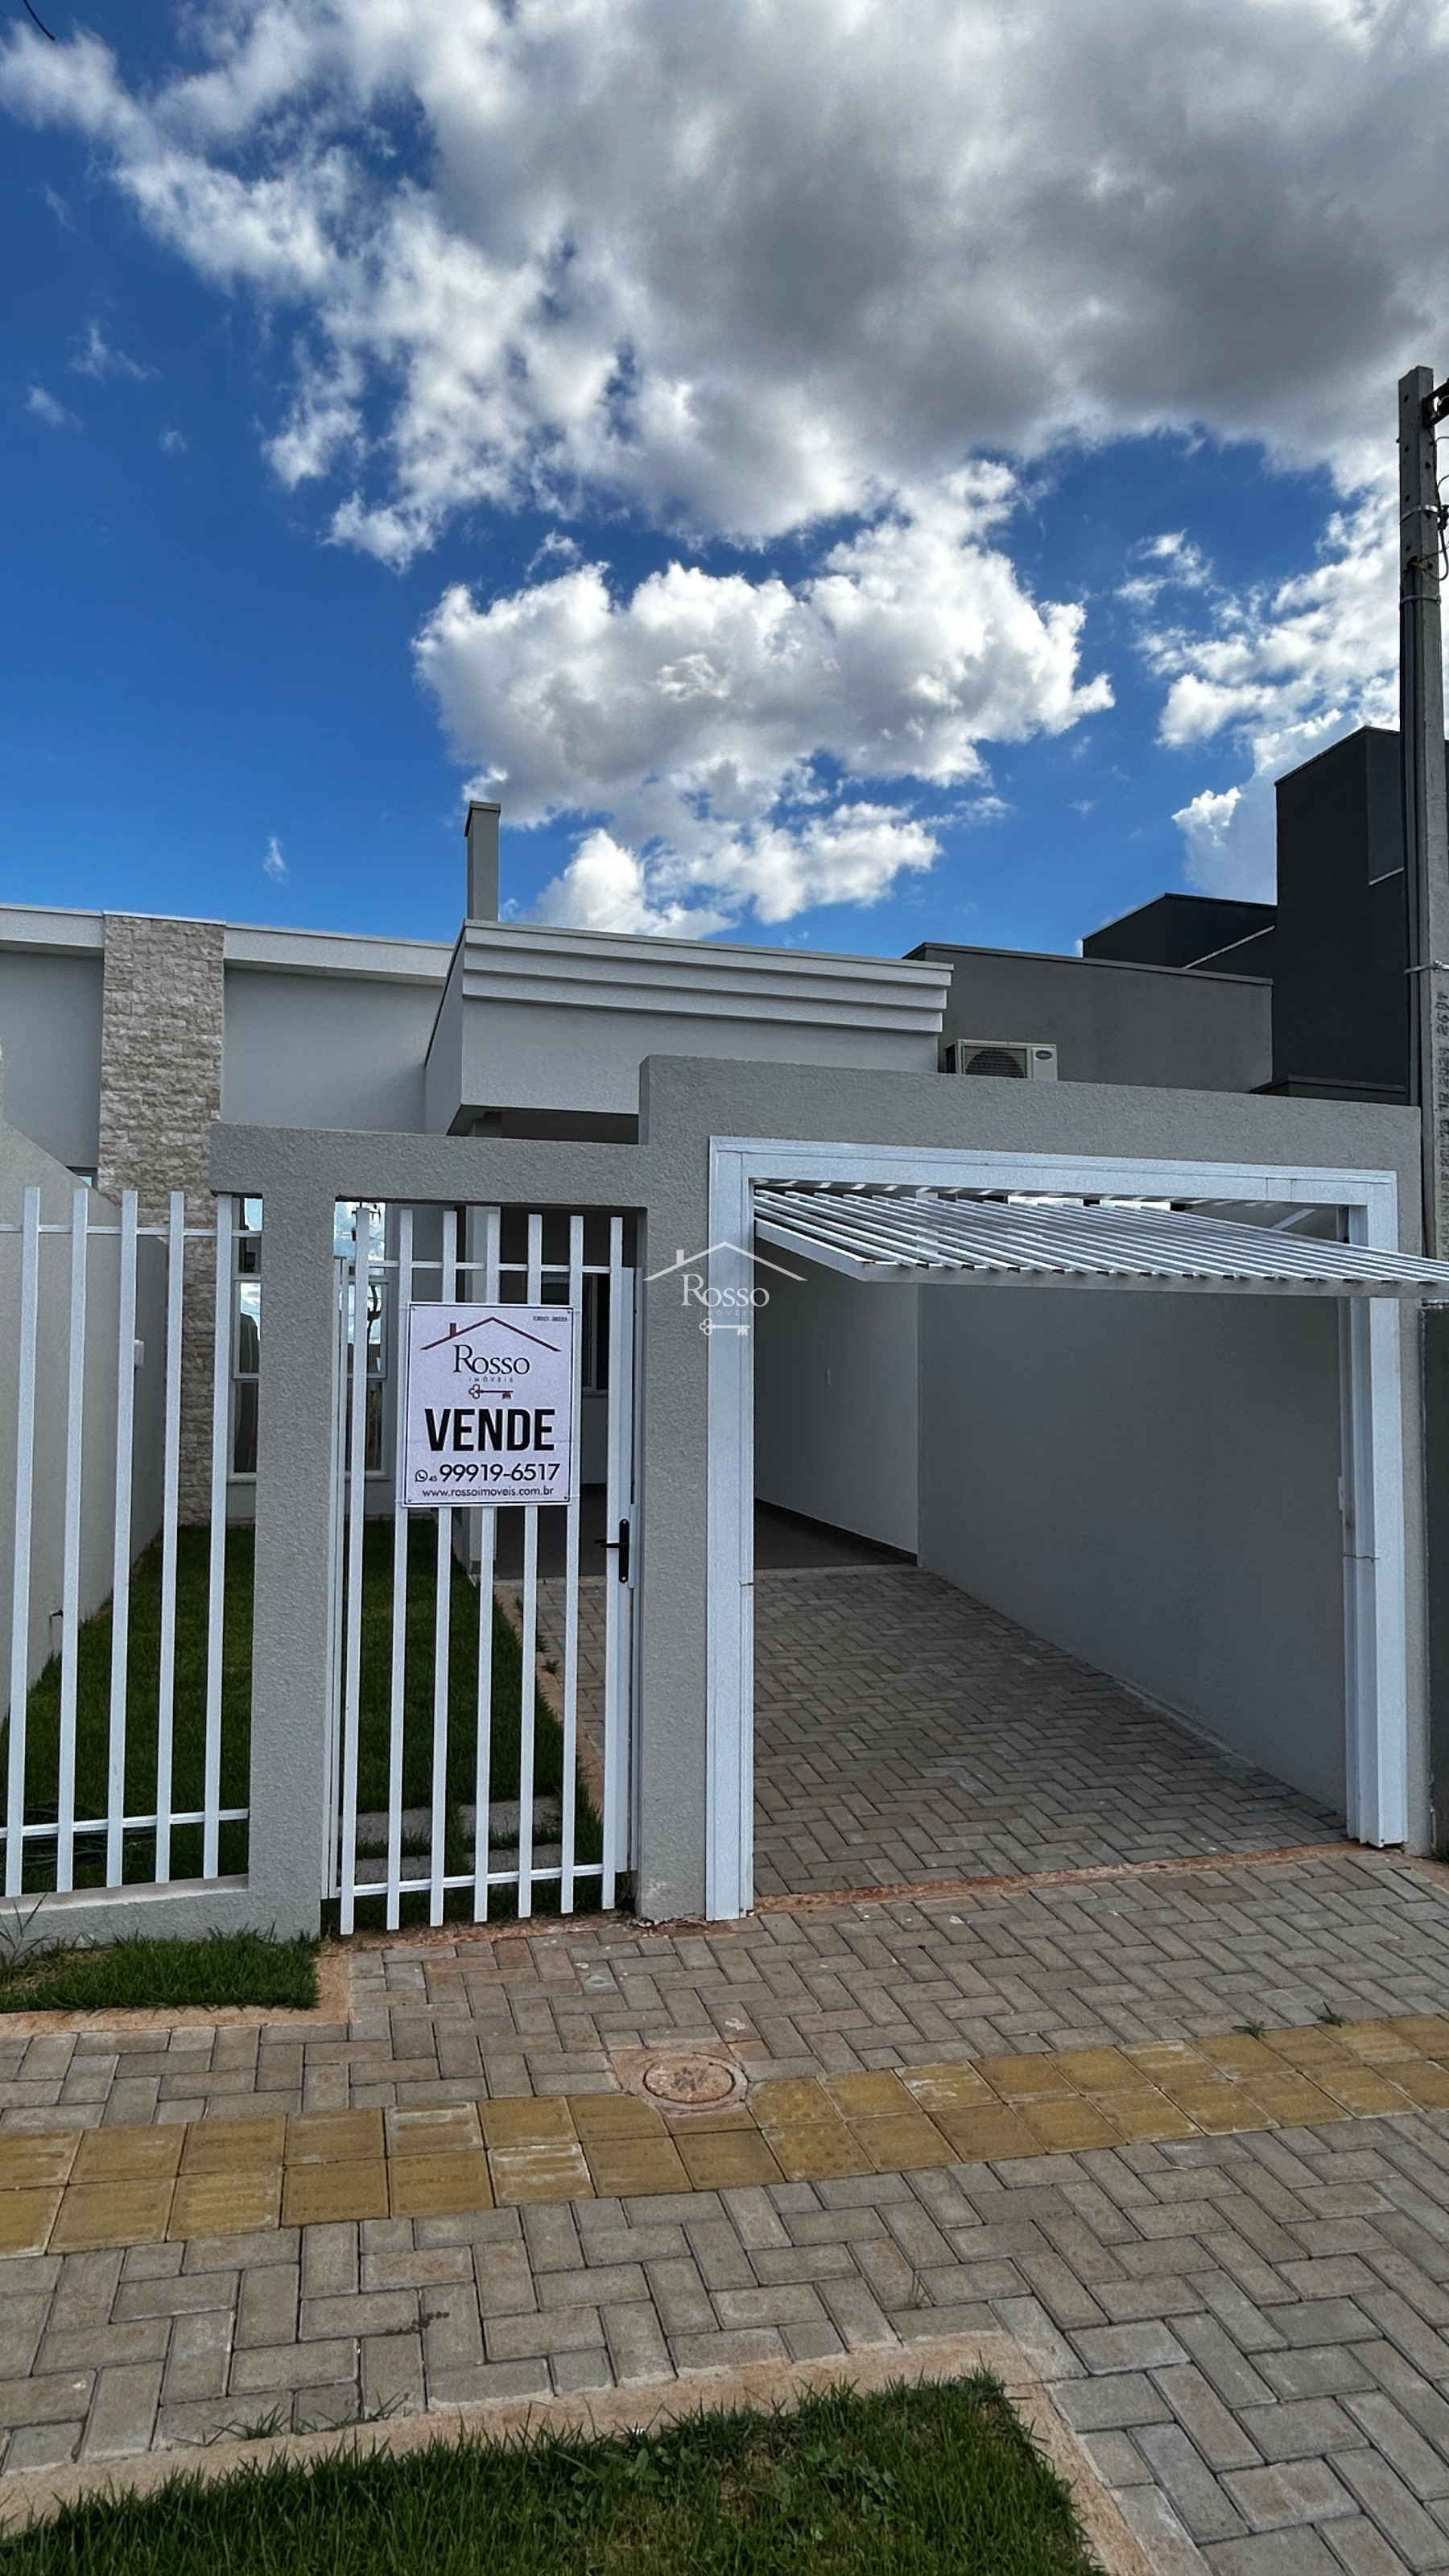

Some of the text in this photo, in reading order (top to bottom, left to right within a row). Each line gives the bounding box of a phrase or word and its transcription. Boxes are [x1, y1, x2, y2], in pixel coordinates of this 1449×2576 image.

[424, 1408, 555, 1451] VENDE
[440, 1463, 561, 1482] 99919-6517
[422, 1485, 554, 1497] www.rossoimoveis.com.br
